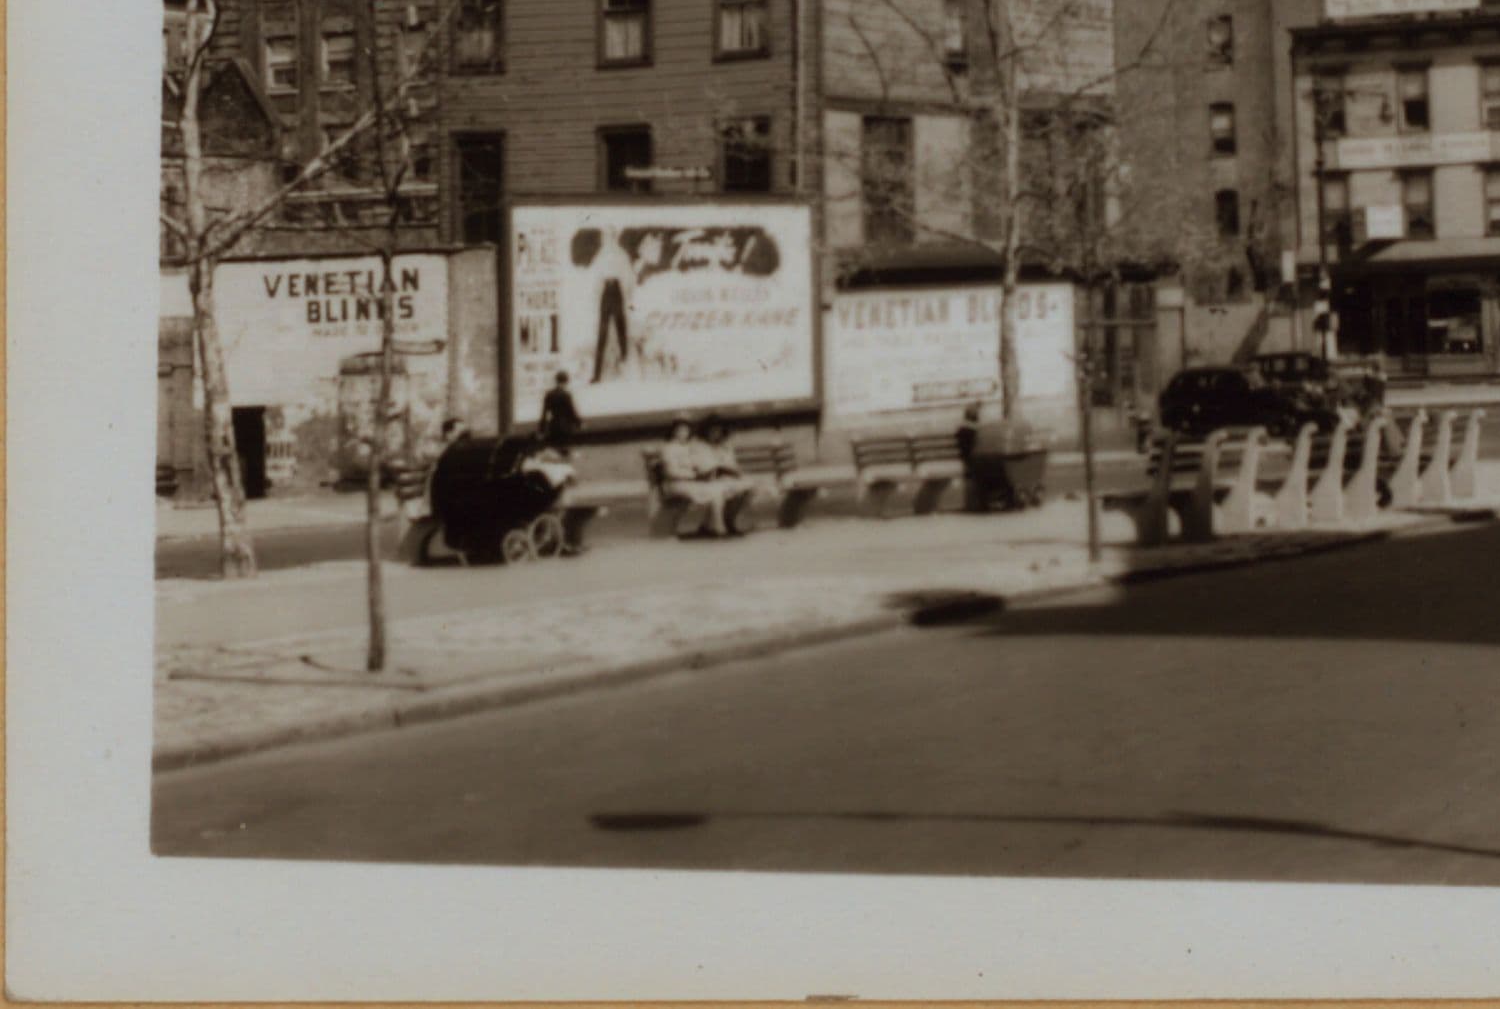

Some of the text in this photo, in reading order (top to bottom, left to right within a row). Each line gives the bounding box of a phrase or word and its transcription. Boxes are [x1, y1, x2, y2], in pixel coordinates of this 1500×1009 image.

[263, 268, 420, 298] VENETIAN
[836, 296, 950, 330] VENETIAN
[548, 313, 561, 355] 1
